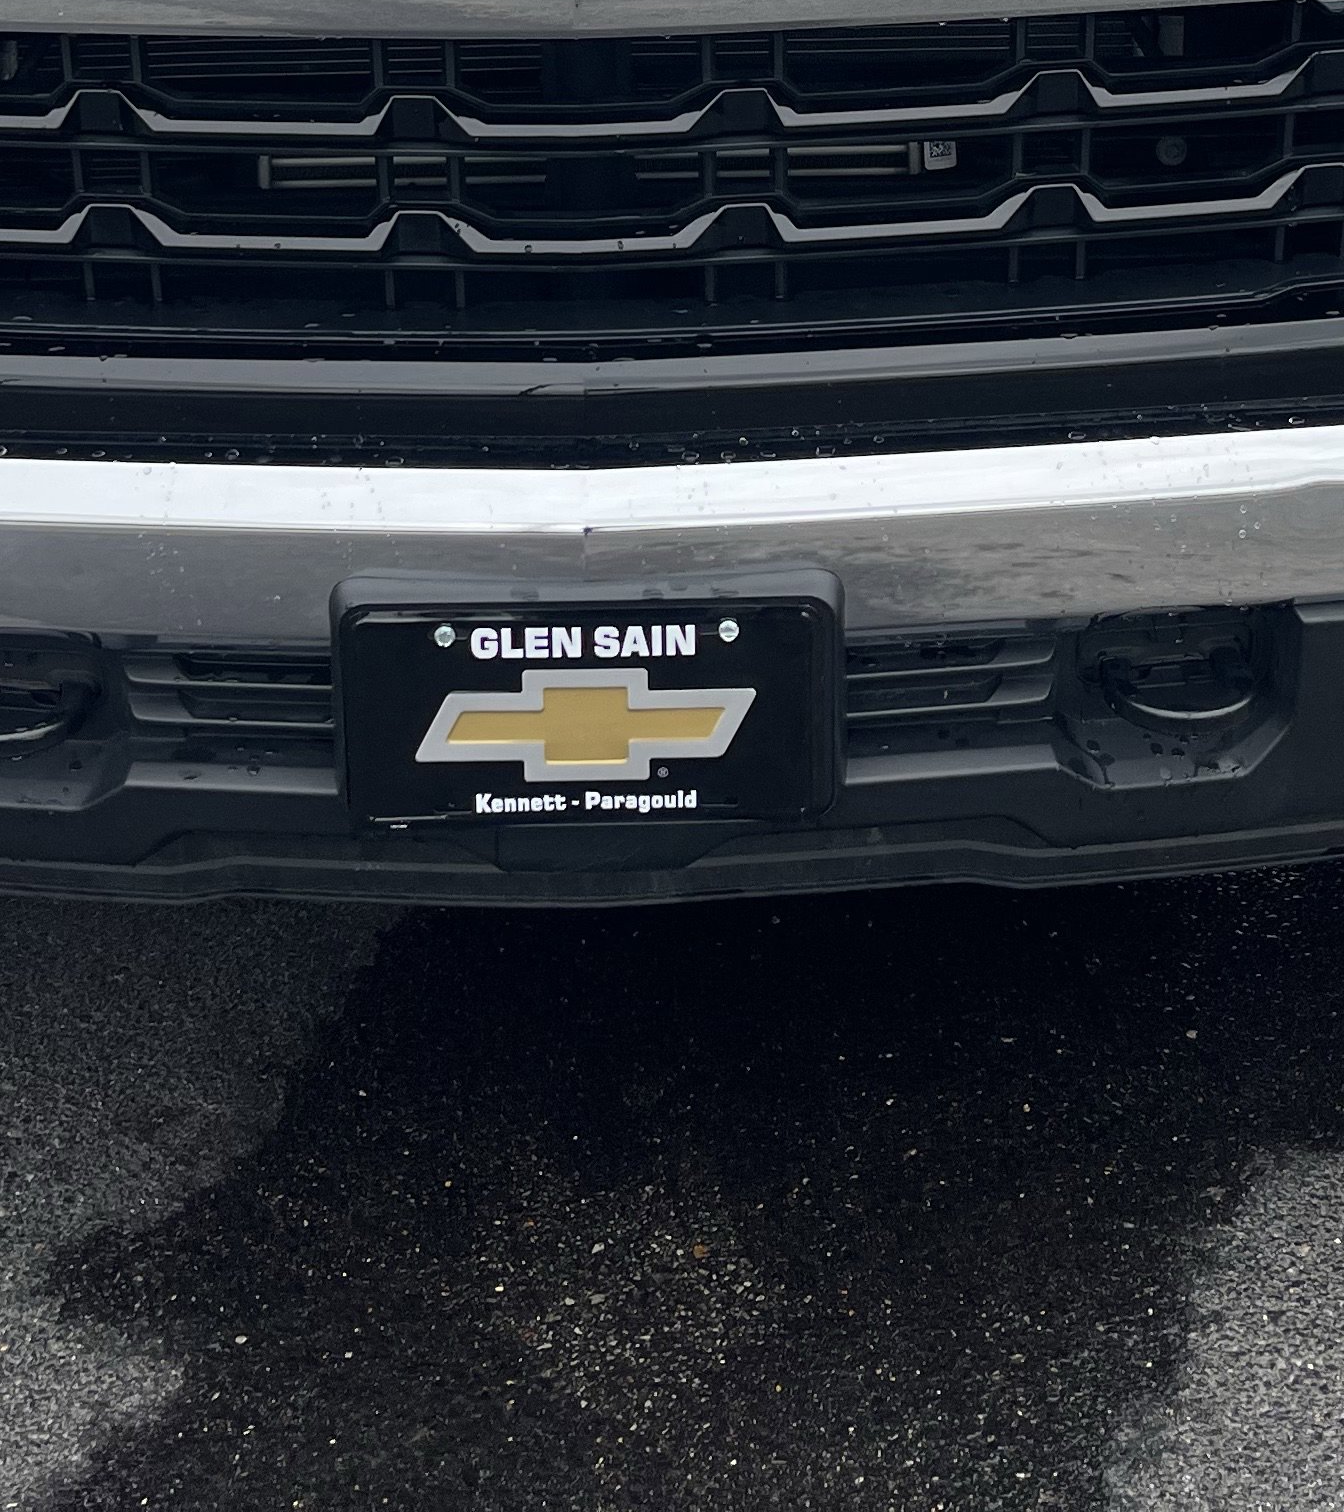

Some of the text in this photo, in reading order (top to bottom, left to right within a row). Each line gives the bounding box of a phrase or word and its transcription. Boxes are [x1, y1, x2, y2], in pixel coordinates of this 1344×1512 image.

[470, 624, 696, 659] GLEN SAIN
[475, 793, 567, 813] Kennett
[585, 790, 698, 813] Paragould
